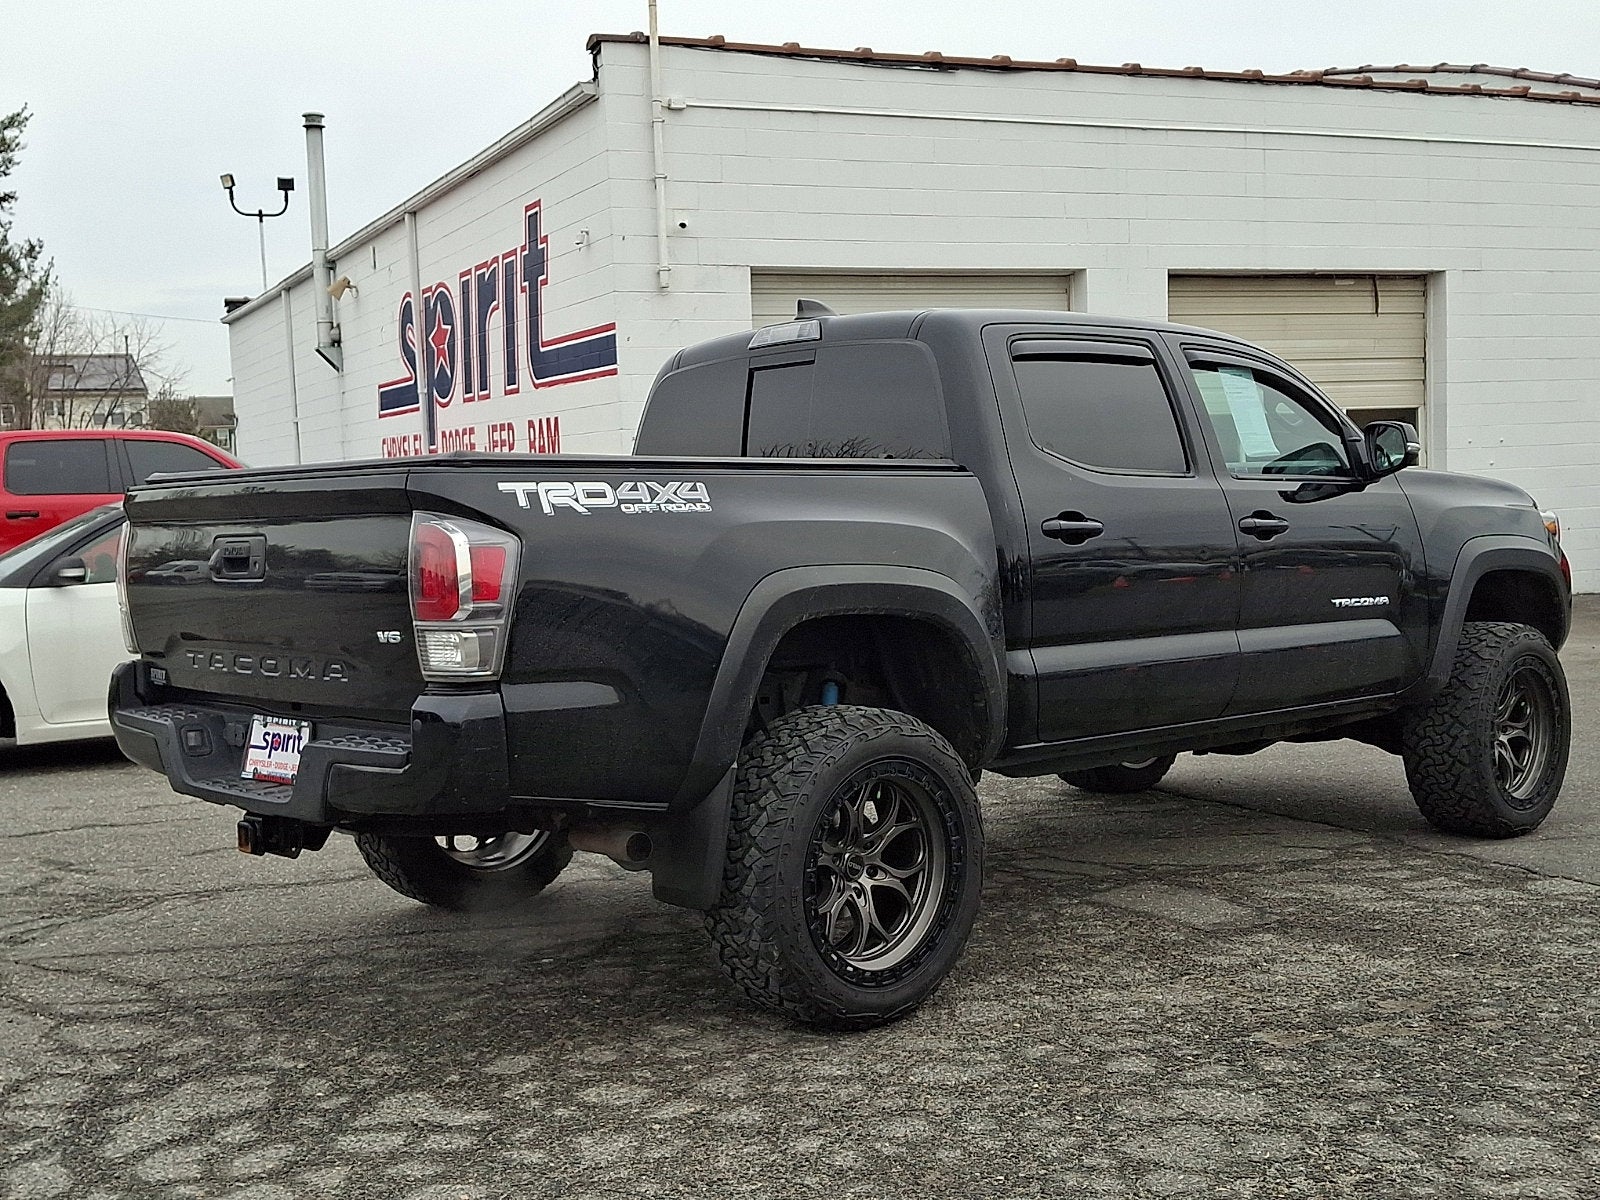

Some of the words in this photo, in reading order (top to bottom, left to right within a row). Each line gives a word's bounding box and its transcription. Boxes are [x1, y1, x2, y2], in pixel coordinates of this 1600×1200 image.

[378, 198, 618, 453] spirit
[442, 426, 475, 453] DODGE
[484, 422, 515, 453] JEEP
[527, 416, 561, 454] RAM
[497, 481, 619, 516] TRD
[620, 502, 660, 514] OFF
[661, 502, 713, 514] ROAD
[1330, 596, 1390, 608] TACOMA
[376, 631, 402, 644] V6
[187, 651, 349, 683] TACOMA
[249, 731, 303, 759] spirit
